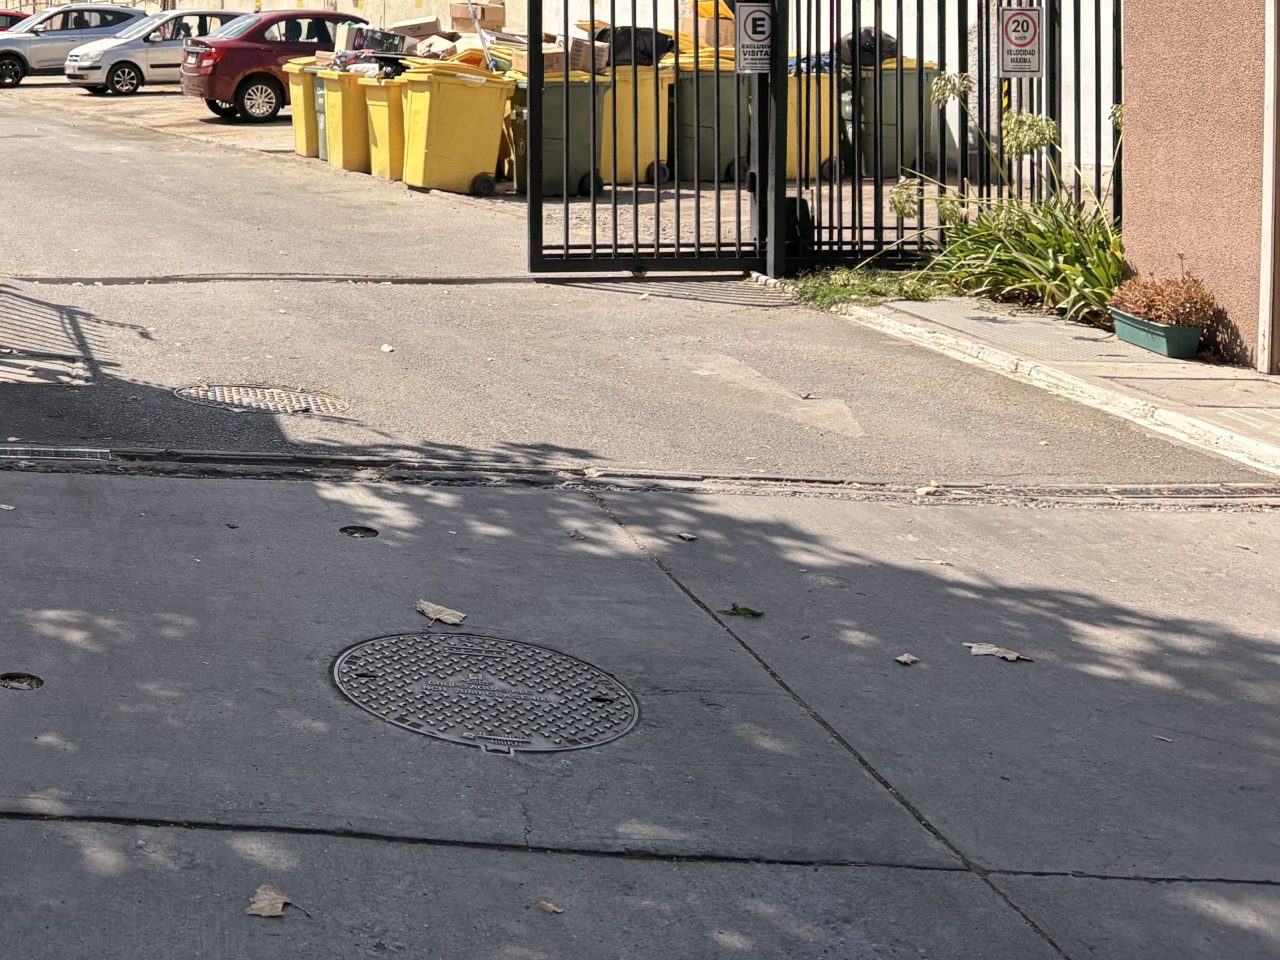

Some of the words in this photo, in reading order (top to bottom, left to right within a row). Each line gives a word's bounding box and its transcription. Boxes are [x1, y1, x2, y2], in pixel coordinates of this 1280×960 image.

[751, 17, 766, 35] E
[1011, 19, 1030, 33] 20
[742, 49, 771, 57] VISITA
